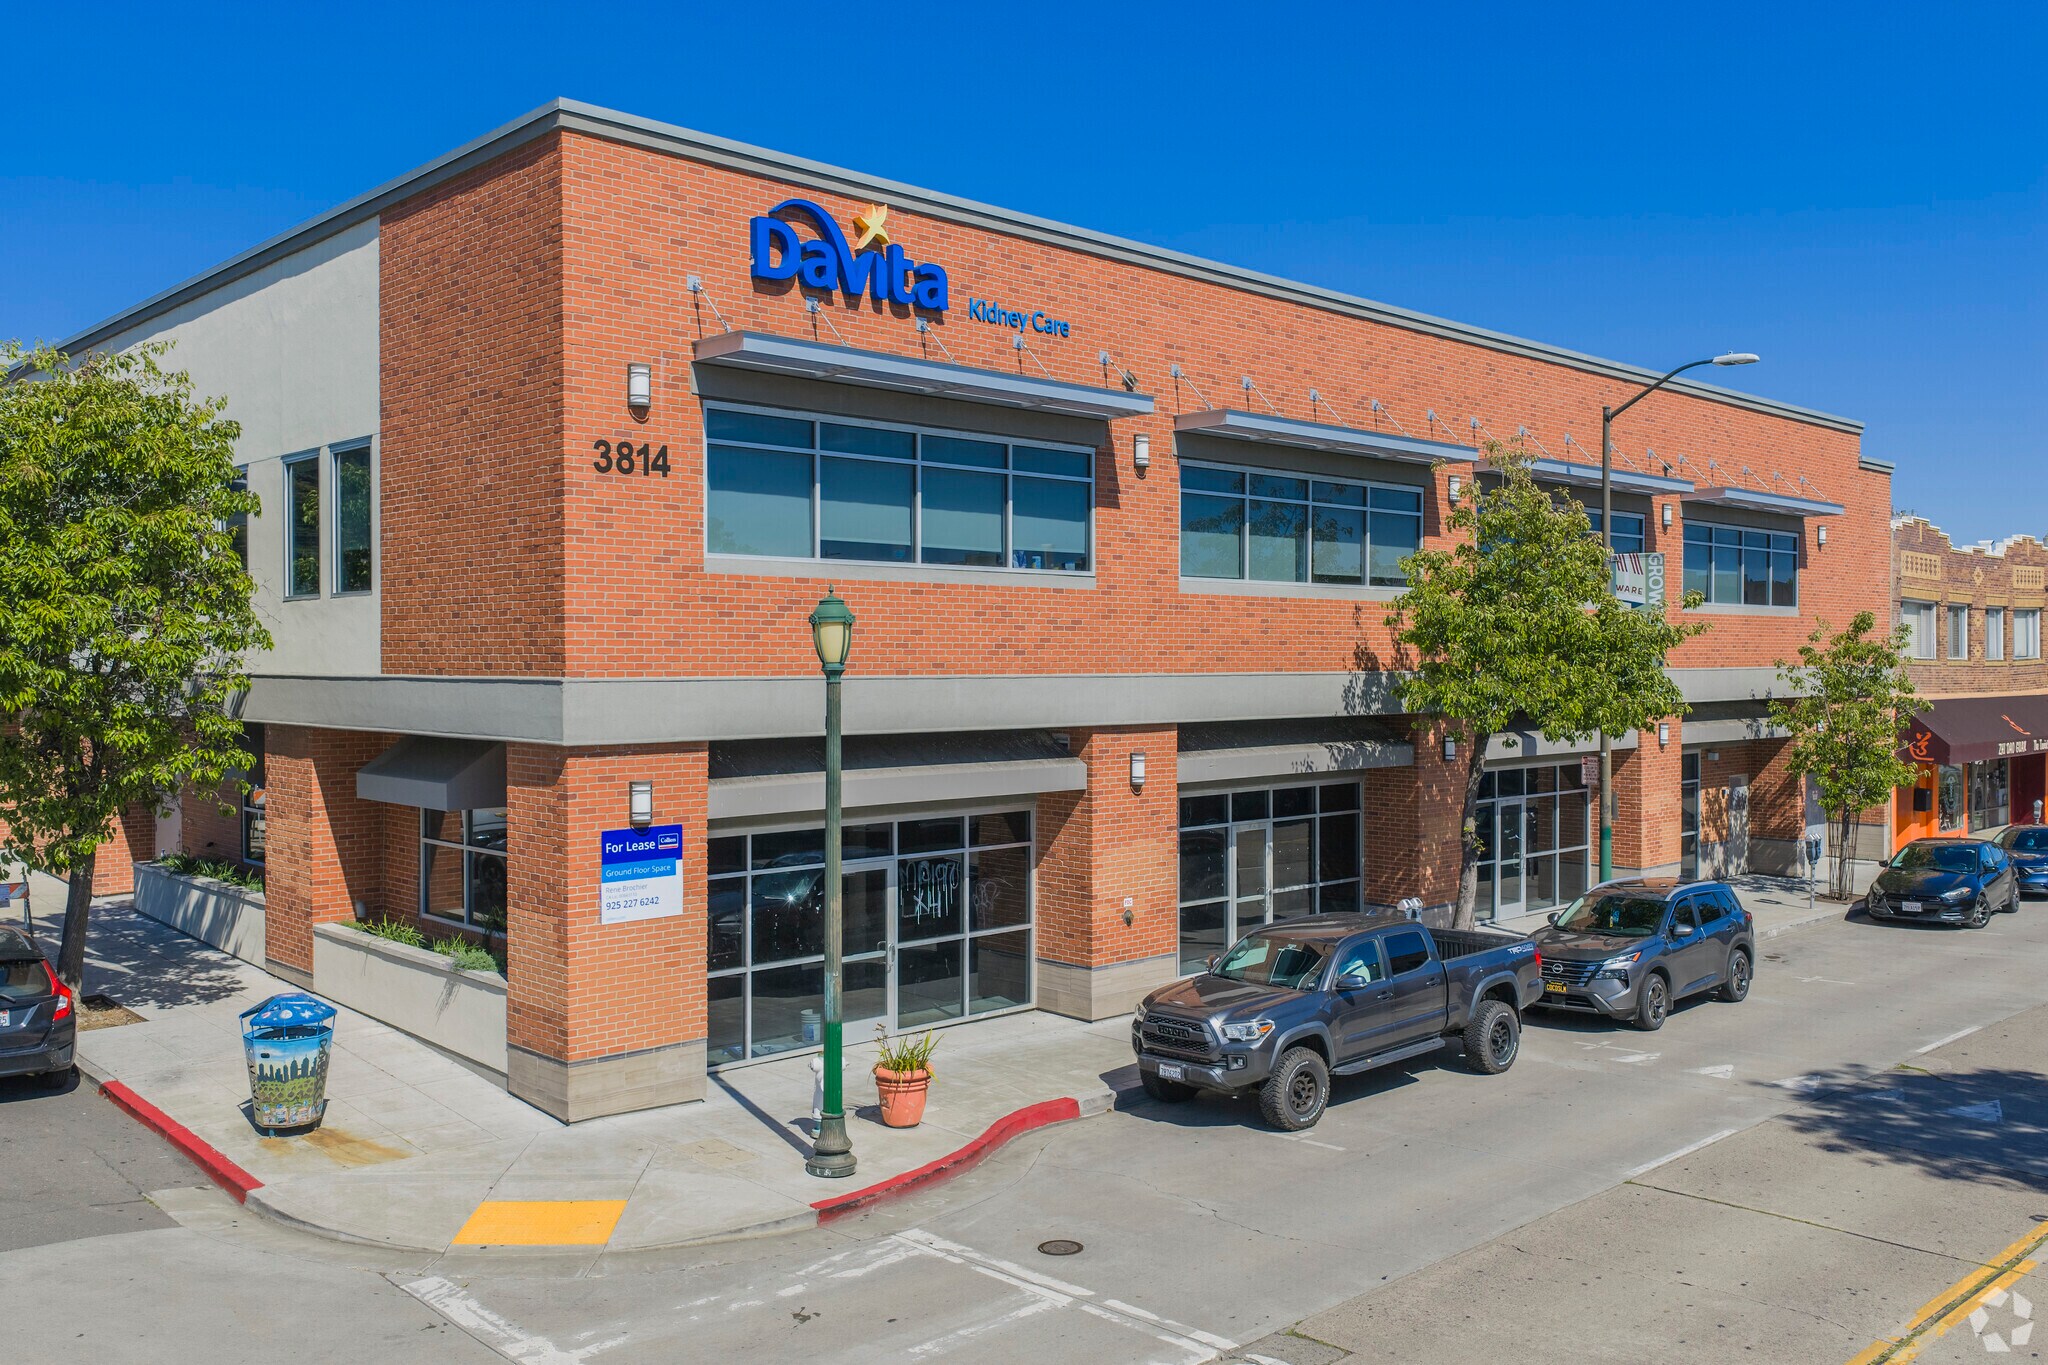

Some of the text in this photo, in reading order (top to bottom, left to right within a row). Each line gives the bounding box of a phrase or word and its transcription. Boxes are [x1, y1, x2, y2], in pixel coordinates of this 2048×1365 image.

[750, 198, 949, 312] DaVita
[969, 297, 1070, 338] Kidney Care
[593, 439, 671, 477] 3814
[1616, 584, 1643, 595] WARE
[605, 841, 656, 854] For Lease
[605, 864, 671, 877] Ground Floor Space
[605, 896, 660, 910] 925 227 6242
[1159, 1026, 1189, 1038] TOYOTA
